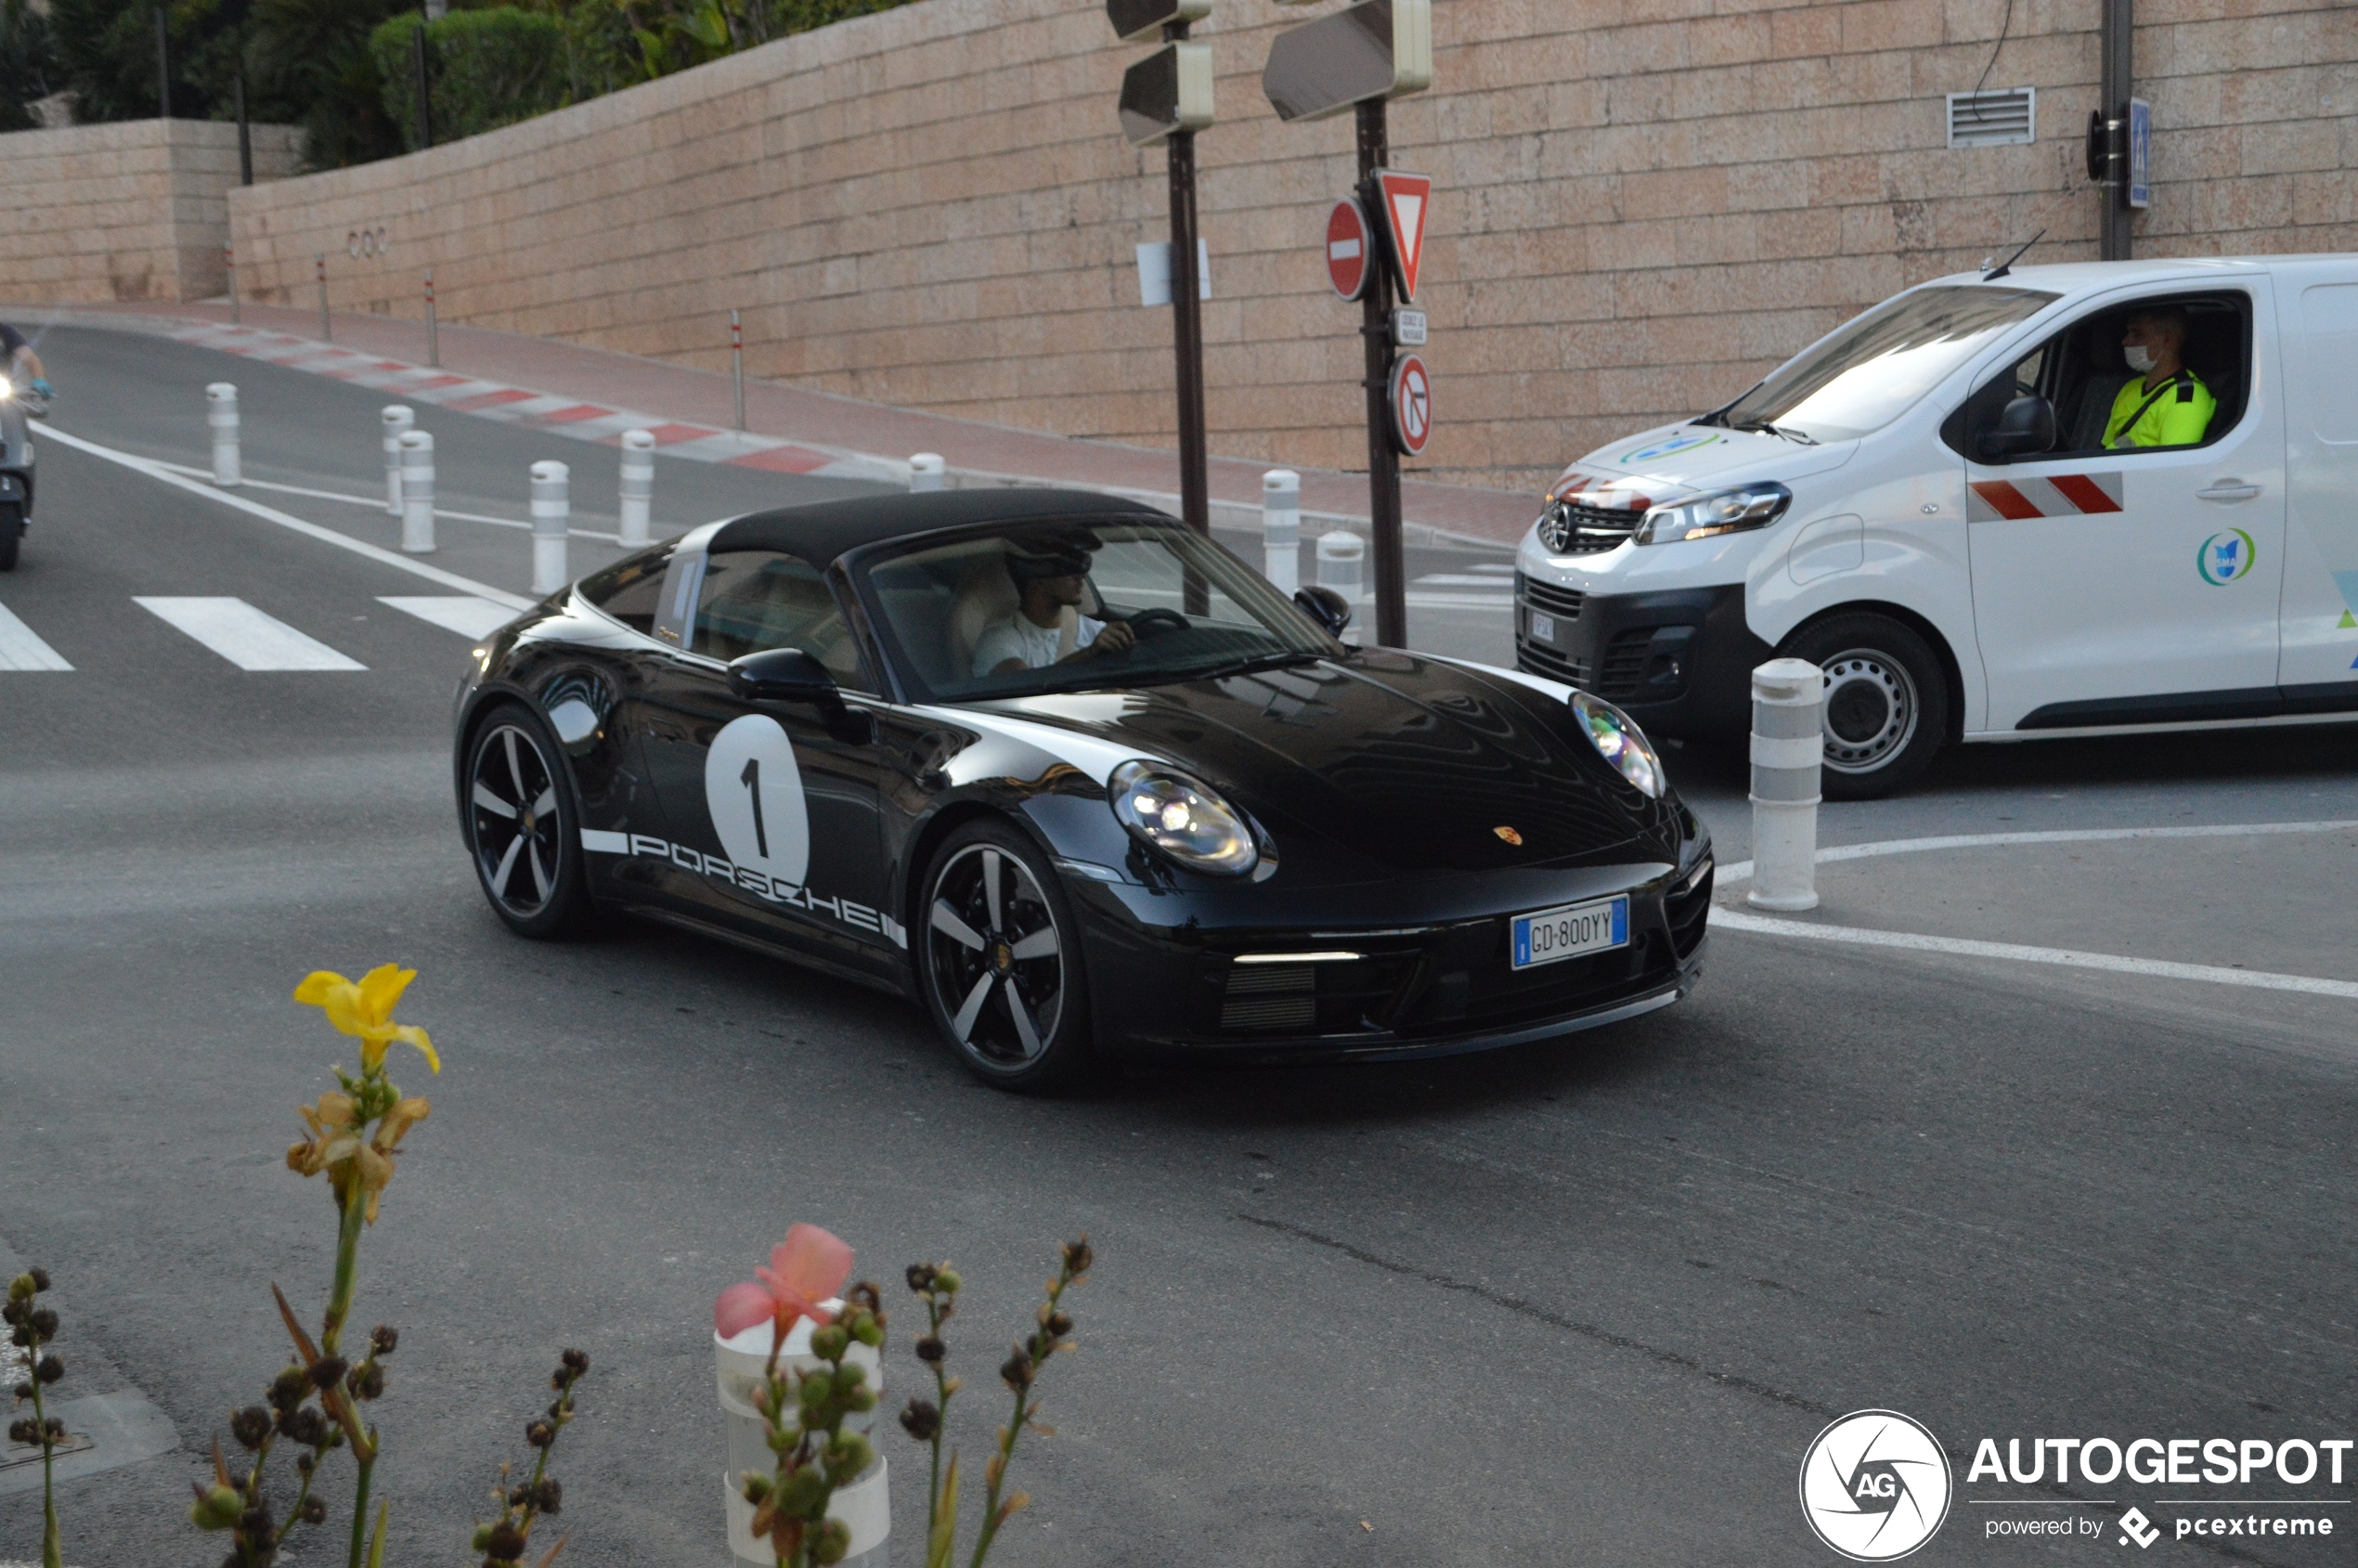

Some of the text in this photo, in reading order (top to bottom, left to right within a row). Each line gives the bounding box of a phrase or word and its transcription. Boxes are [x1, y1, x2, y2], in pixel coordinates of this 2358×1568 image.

[2216, 557, 2236, 568] SMA
[739, 758, 770, 860] 1
[629, 833, 882, 934] PORSCHE
